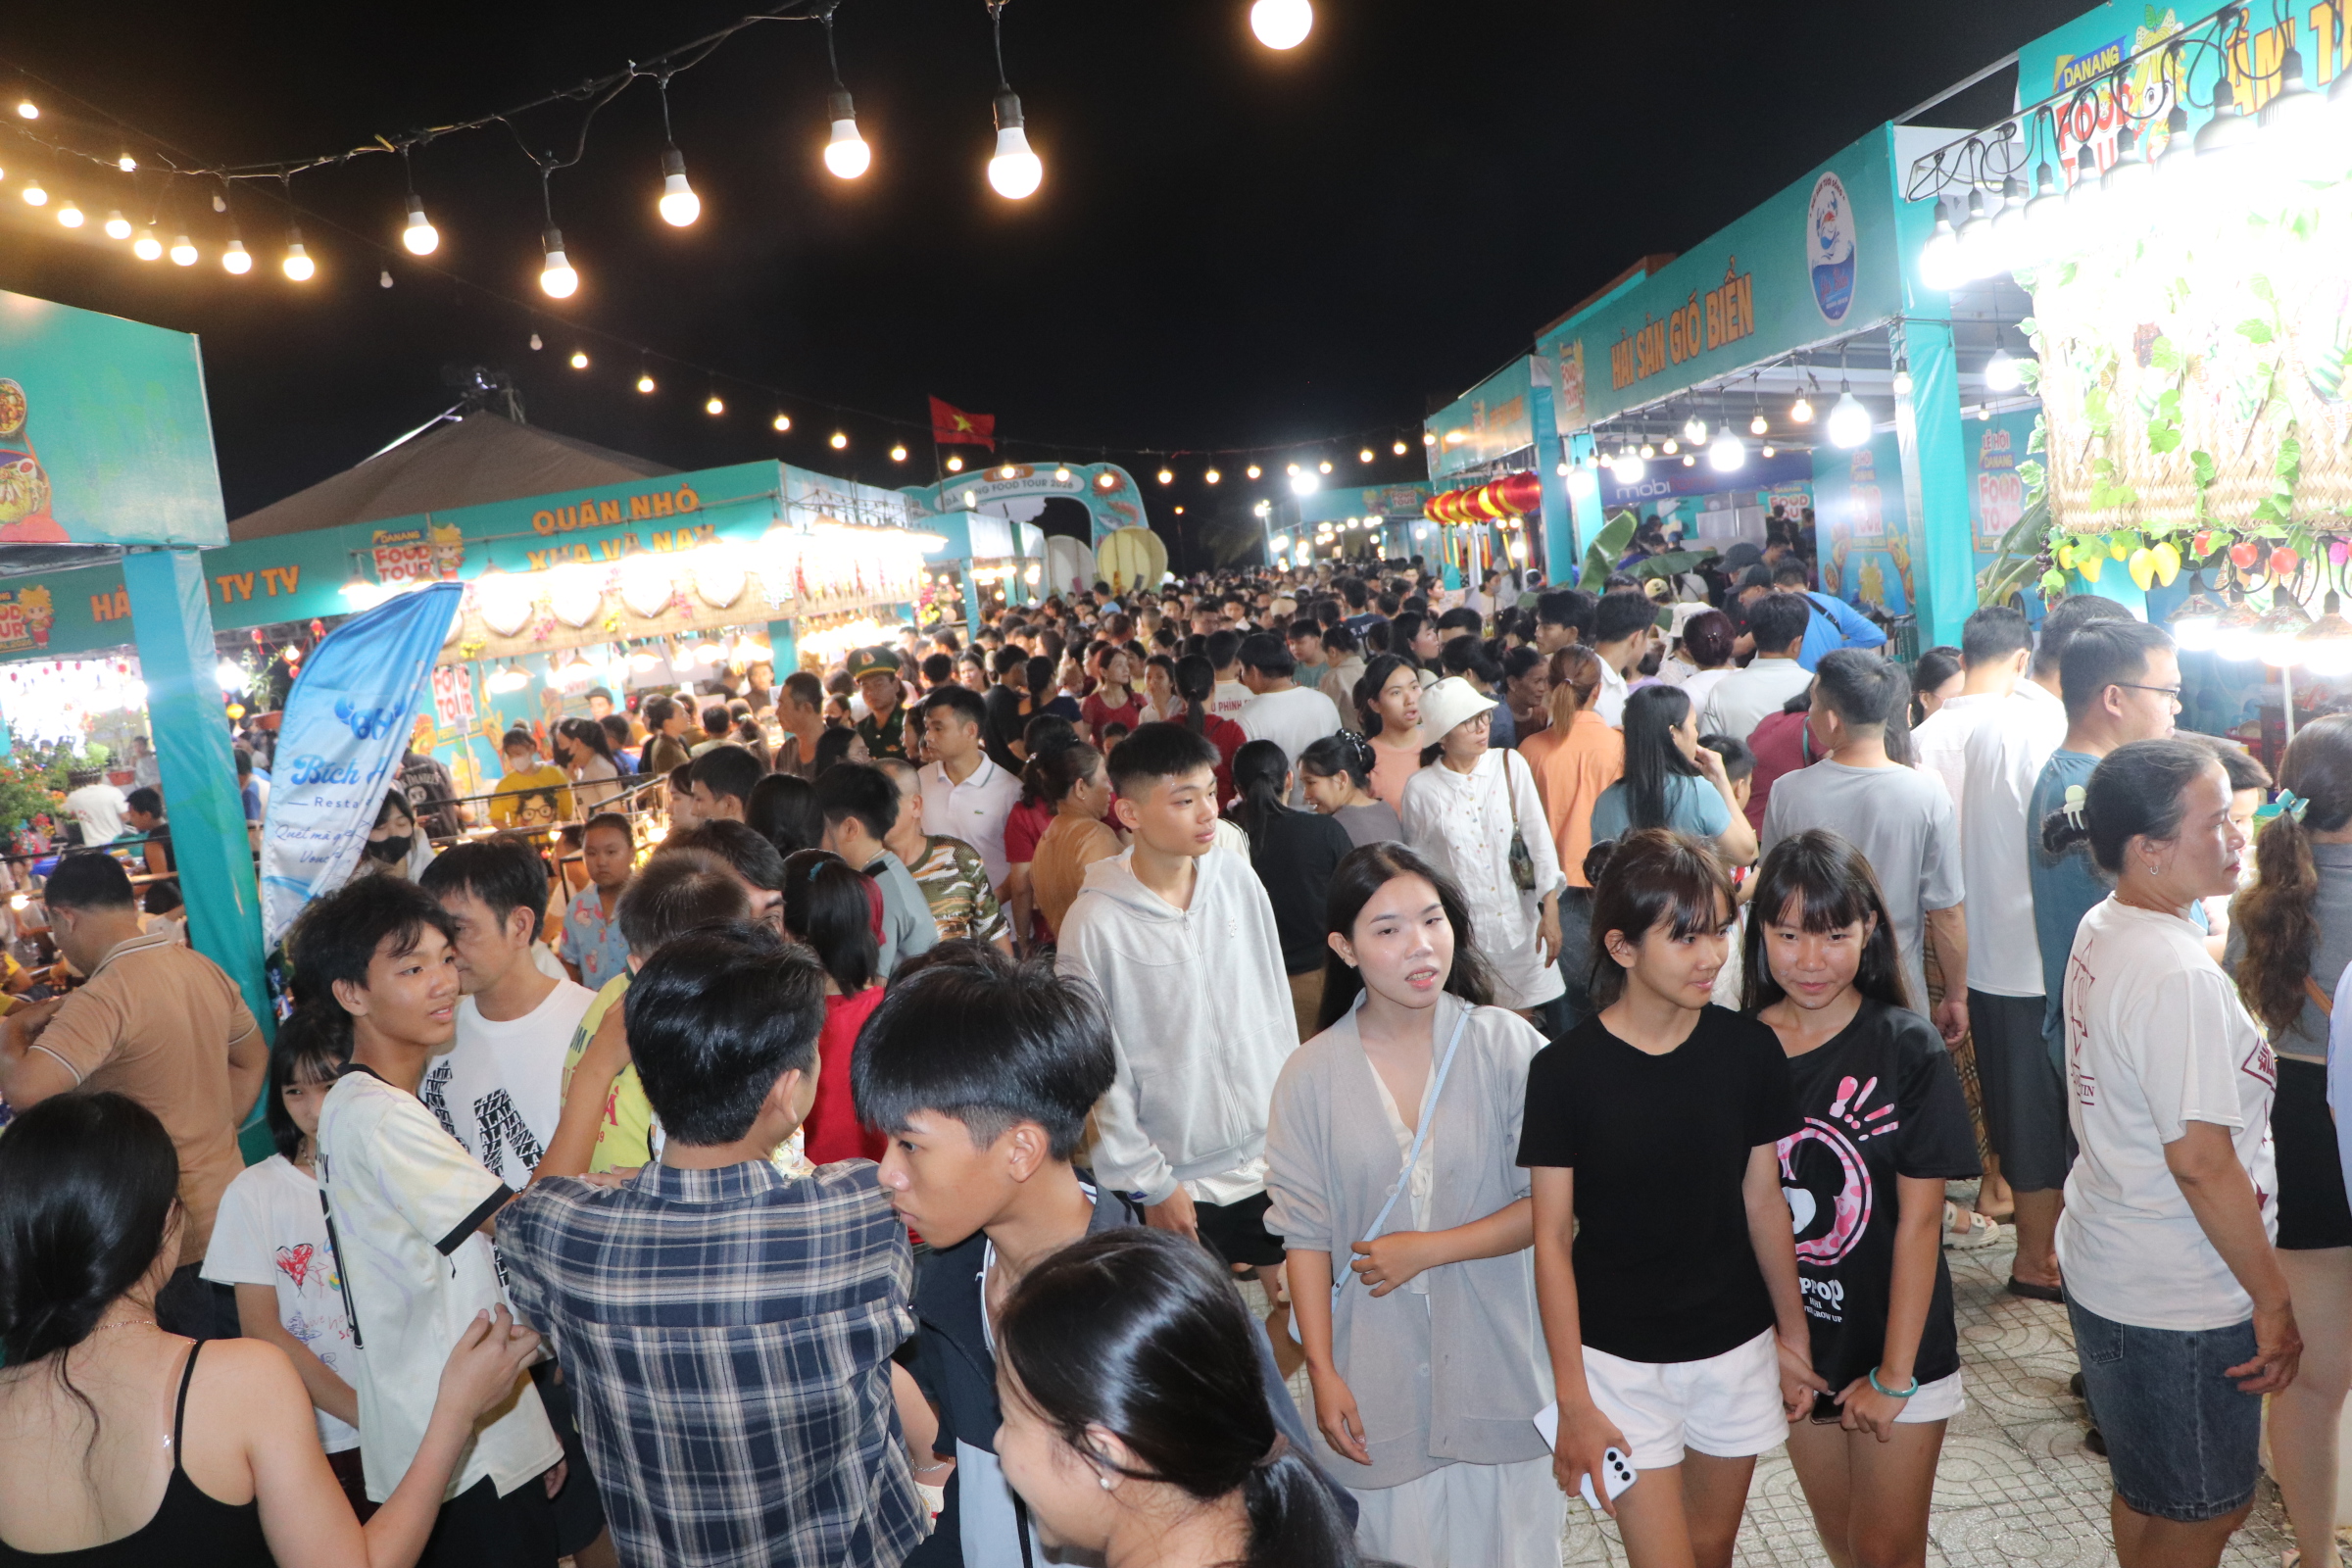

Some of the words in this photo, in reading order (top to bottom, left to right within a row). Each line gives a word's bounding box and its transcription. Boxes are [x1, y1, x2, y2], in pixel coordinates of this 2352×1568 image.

[2063, 44, 2120, 88] DANANG
[1611, 327, 1634, 391] HẢI
[1636, 312, 1665, 380] SẢN
[1669, 287, 1701, 366] GIÓ
[1705, 255, 1754, 351] BIỂN
[1992, 429, 2010, 451] HỘI
[1984, 455, 2013, 468] DANANG
[992, 481, 1019, 491] FOOD
[1022, 479, 1048, 488] TOUR
[1051, 479, 1074, 489] 2026
[1980, 473, 2020, 503] FOOD
[532, 499, 622, 536] QUÁN
[630, 482, 700, 520] NHỎ
[1770, 495, 1809, 508] FOOD
[380, 530, 421, 544] DANANG
[374, 545, 432, 566] FOOD
[216, 571, 255, 604] TY
[260, 564, 299, 597] TY
[291, 754, 362, 785] Bích
